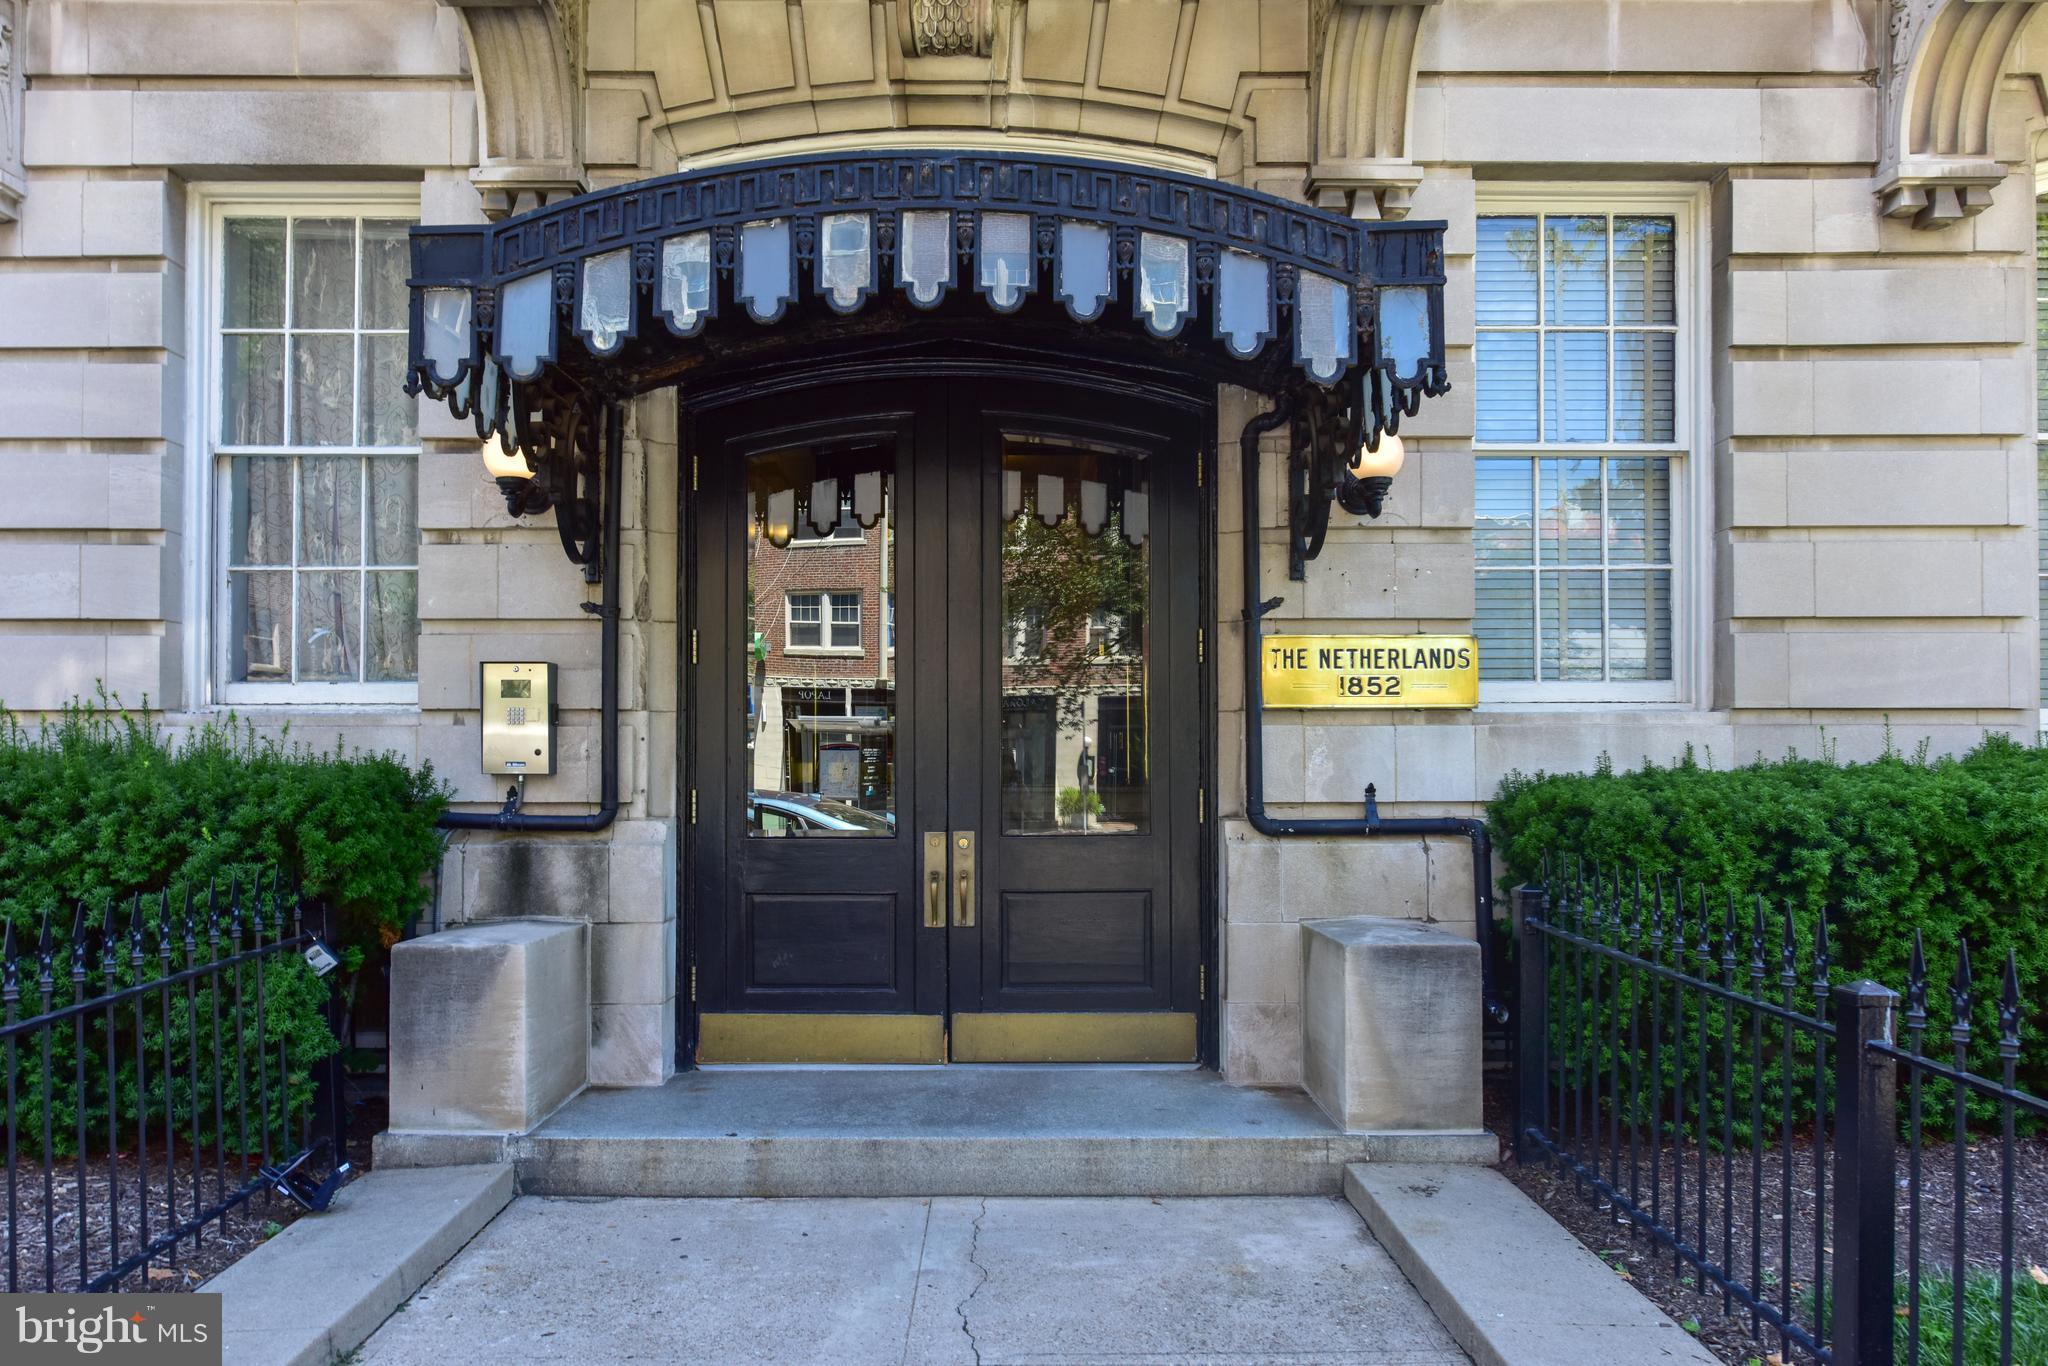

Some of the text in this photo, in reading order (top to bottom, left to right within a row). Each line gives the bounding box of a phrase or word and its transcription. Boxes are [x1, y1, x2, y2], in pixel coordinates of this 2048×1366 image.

[1271, 648, 1471, 670] THE NETHERLANDS
[1339, 676, 1401, 696] 1852
